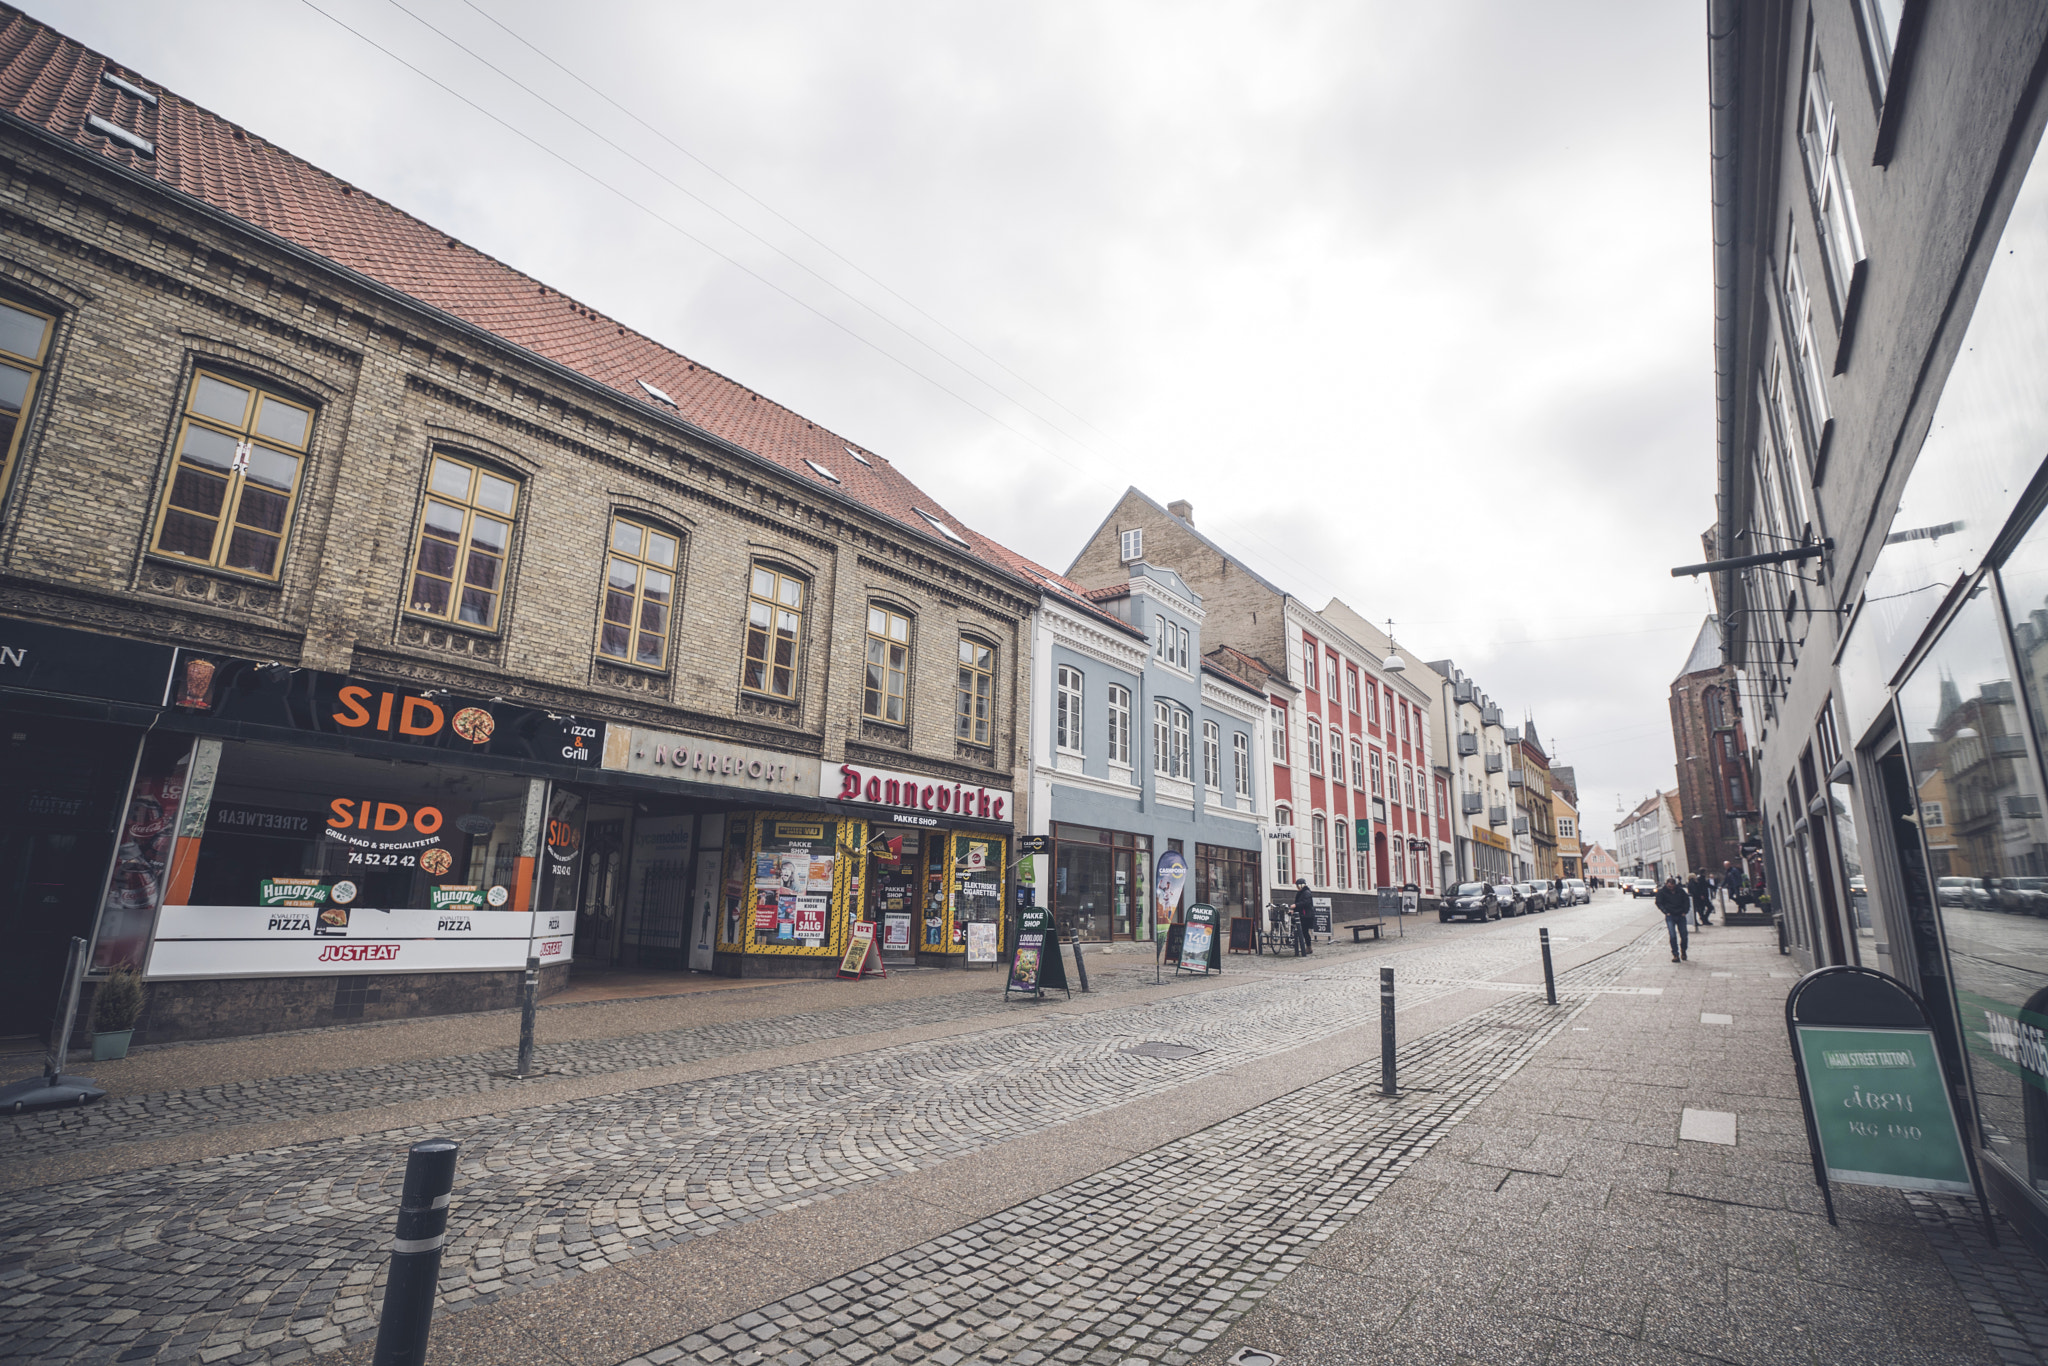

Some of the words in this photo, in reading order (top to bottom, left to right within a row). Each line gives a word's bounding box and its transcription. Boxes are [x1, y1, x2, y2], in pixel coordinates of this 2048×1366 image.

[574, 736, 584, 748] &
[562, 746, 588, 761] Grill
[838, 763, 1005, 820] Dannevirke
[326, 798, 443, 835] SIDO
[893, 814, 918, 824] PAKKE
[918, 817, 938, 826] SHOP
[325, 828, 347, 842] GRILL
[349, 837, 370, 848] MAD
[379, 836, 441, 850] SPECIALITETER
[1269, 831, 1291, 839] RAFINÉ
[348, 852, 363, 864] 74
[365, 854, 380, 865] 52
[382, 855, 398, 866] 42
[400, 855, 415, 867] 42
[964, 881, 997, 890] ELEKTRISKE
[263, 883, 326, 901] Hungry.dk
[433, 889, 483, 906] Hungry.dk
[963, 888, 997, 897] CIGARETTER
[804, 912, 817, 921] TIL
[1191, 907, 1213, 916] PAKKE
[268, 919, 311, 931] PIZZA
[437, 920, 472, 931] PIZZA
[798, 921, 821, 931] SALG
[856, 925, 871, 933] BT
[1187, 931, 1209, 945] 140
[319, 945, 365, 961] JUST
[365, 945, 400, 961] EAT
[1828, 1052, 1851, 1067] MAIN
[1849, 1052, 1880, 1067] STREET
[1878, 1051, 1910, 1066] TATTOO
